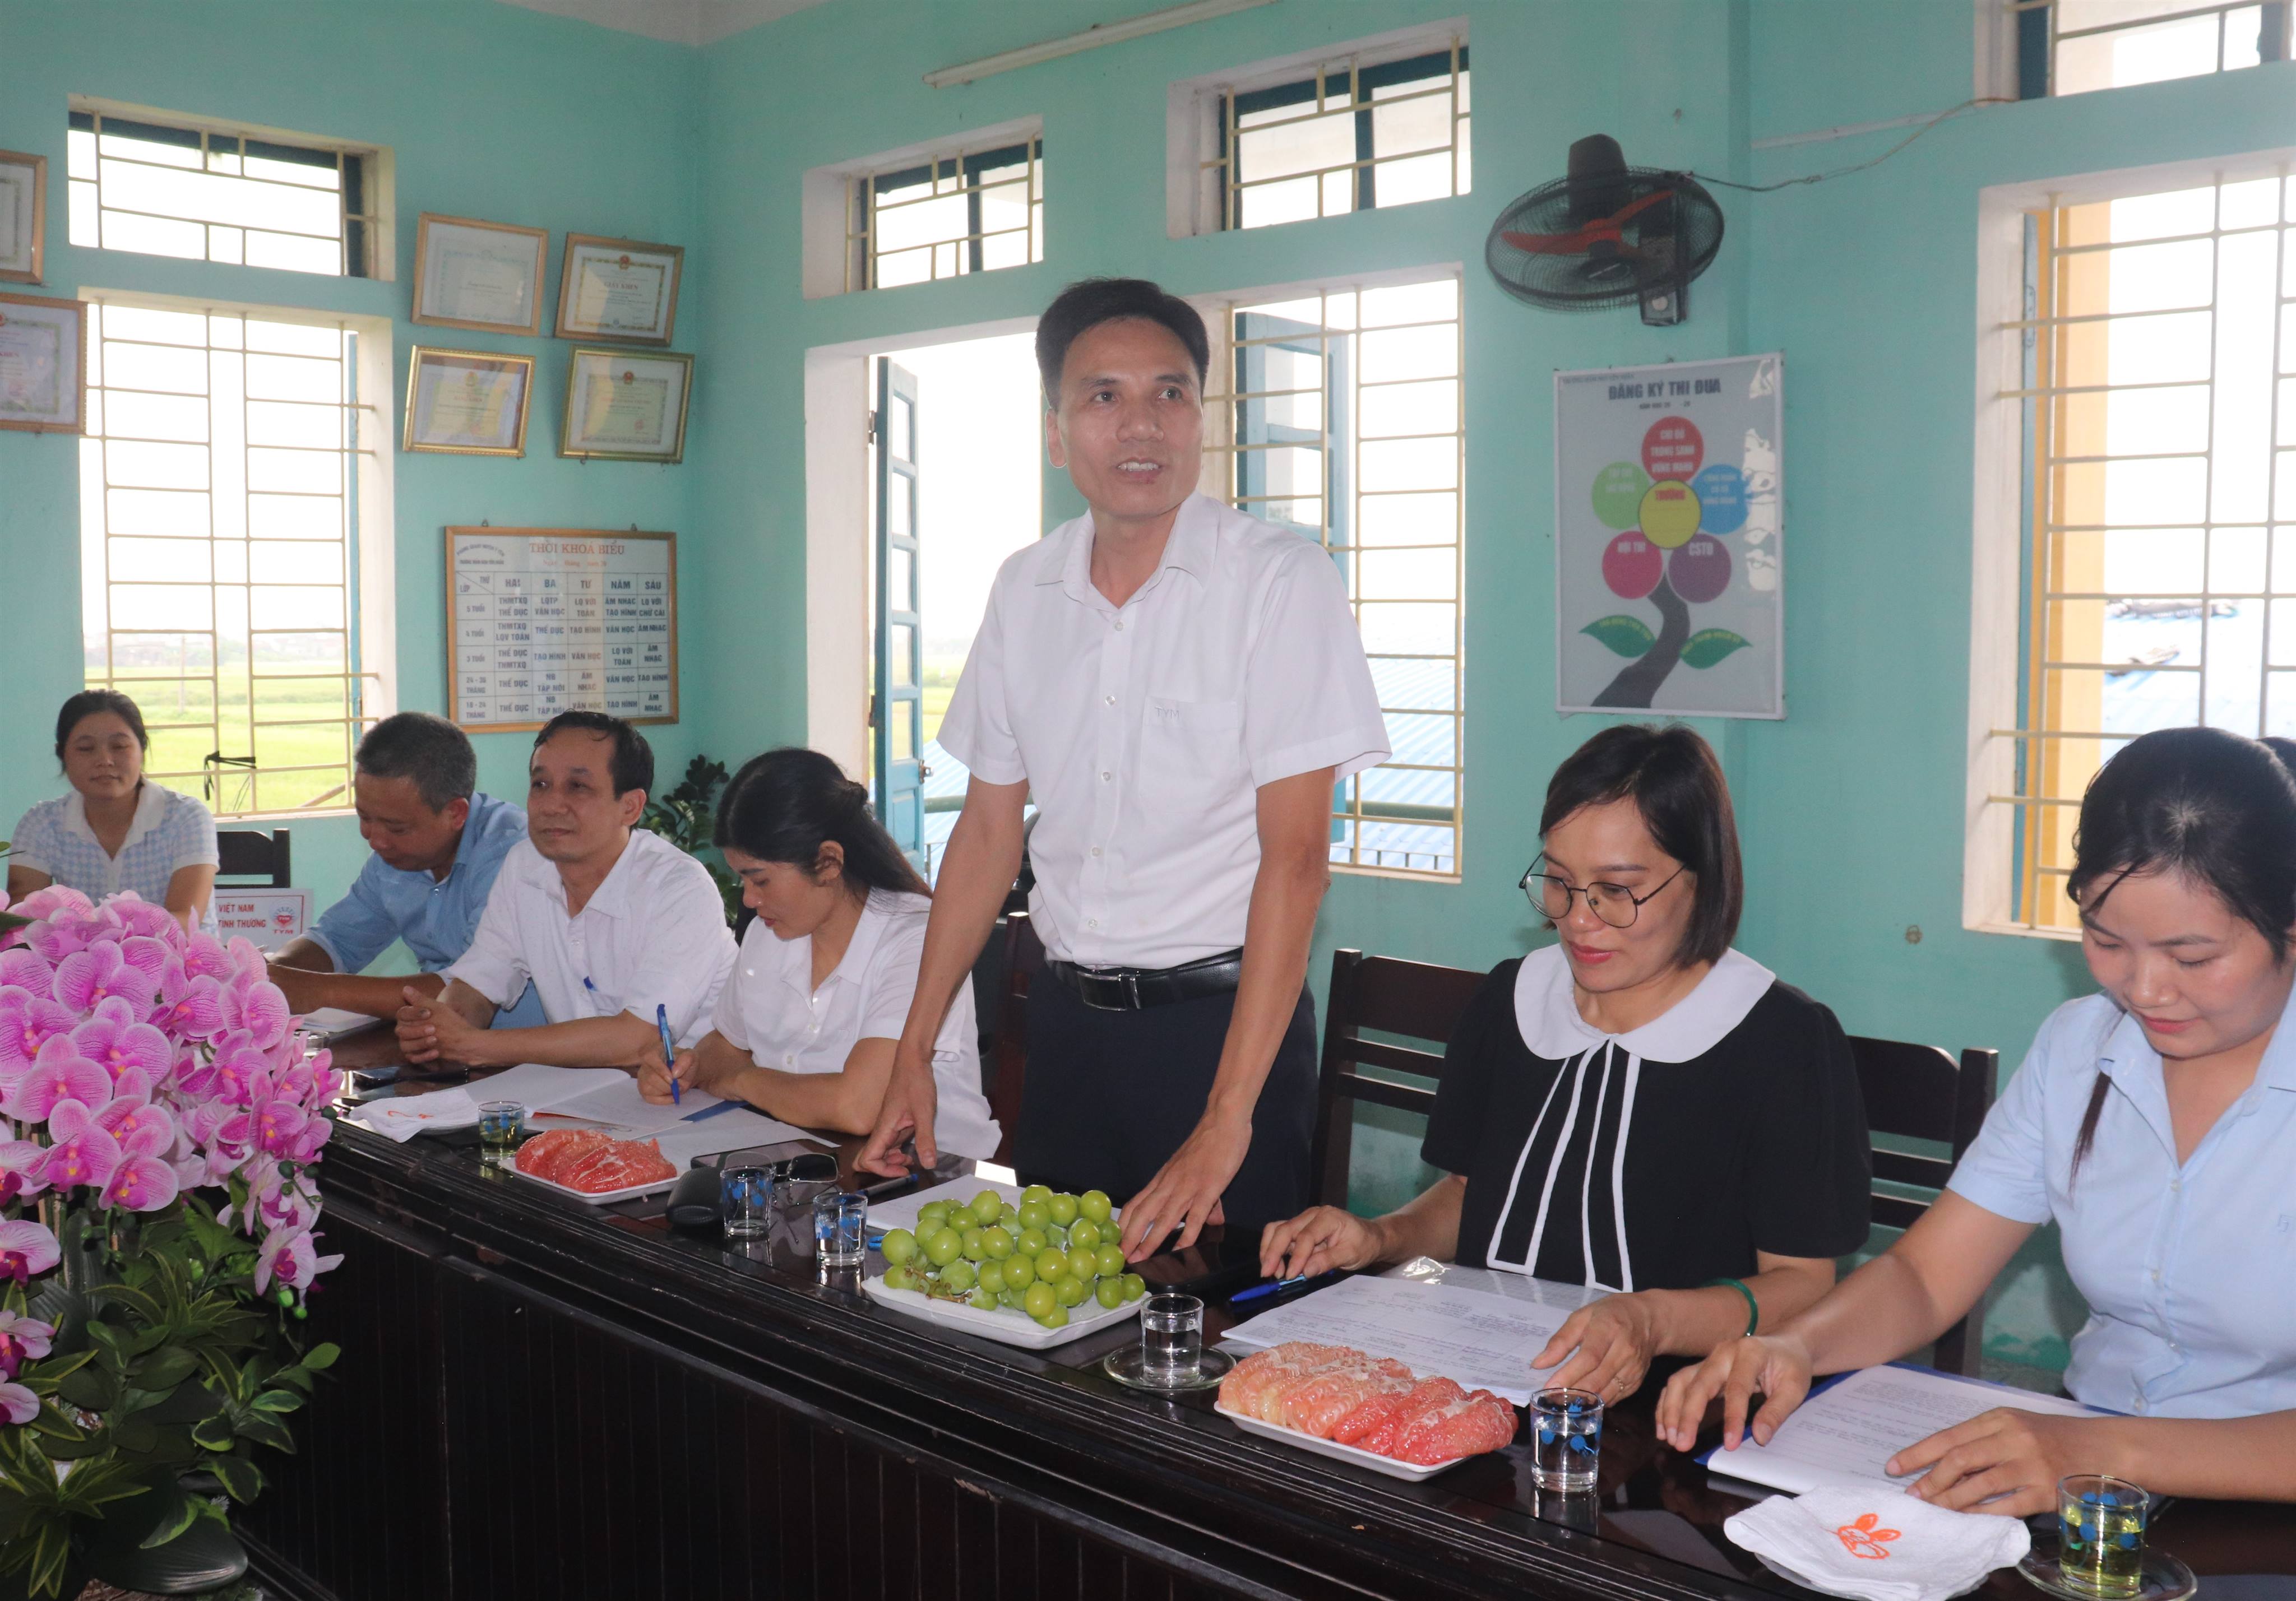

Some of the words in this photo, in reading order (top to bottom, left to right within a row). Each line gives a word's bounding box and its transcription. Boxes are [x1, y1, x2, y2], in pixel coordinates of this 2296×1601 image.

[1609, 383, 1643, 400] ĐĂNG
[1648, 379, 1664, 397] KÝ
[1669, 380, 1690, 396] THI
[1695, 379, 1721, 395] ĐUA
[506, 578, 521, 587] HAI
[544, 579, 556, 588] BA
[581, 580, 591, 588] TƯ
[611, 579, 631, 589] NĂM
[1155, 706, 1179, 718] TYM
[219, 902, 235, 913] VIỆT
[238, 904, 254, 912] NAM
[237, 918, 266, 927] THƯƠNG
